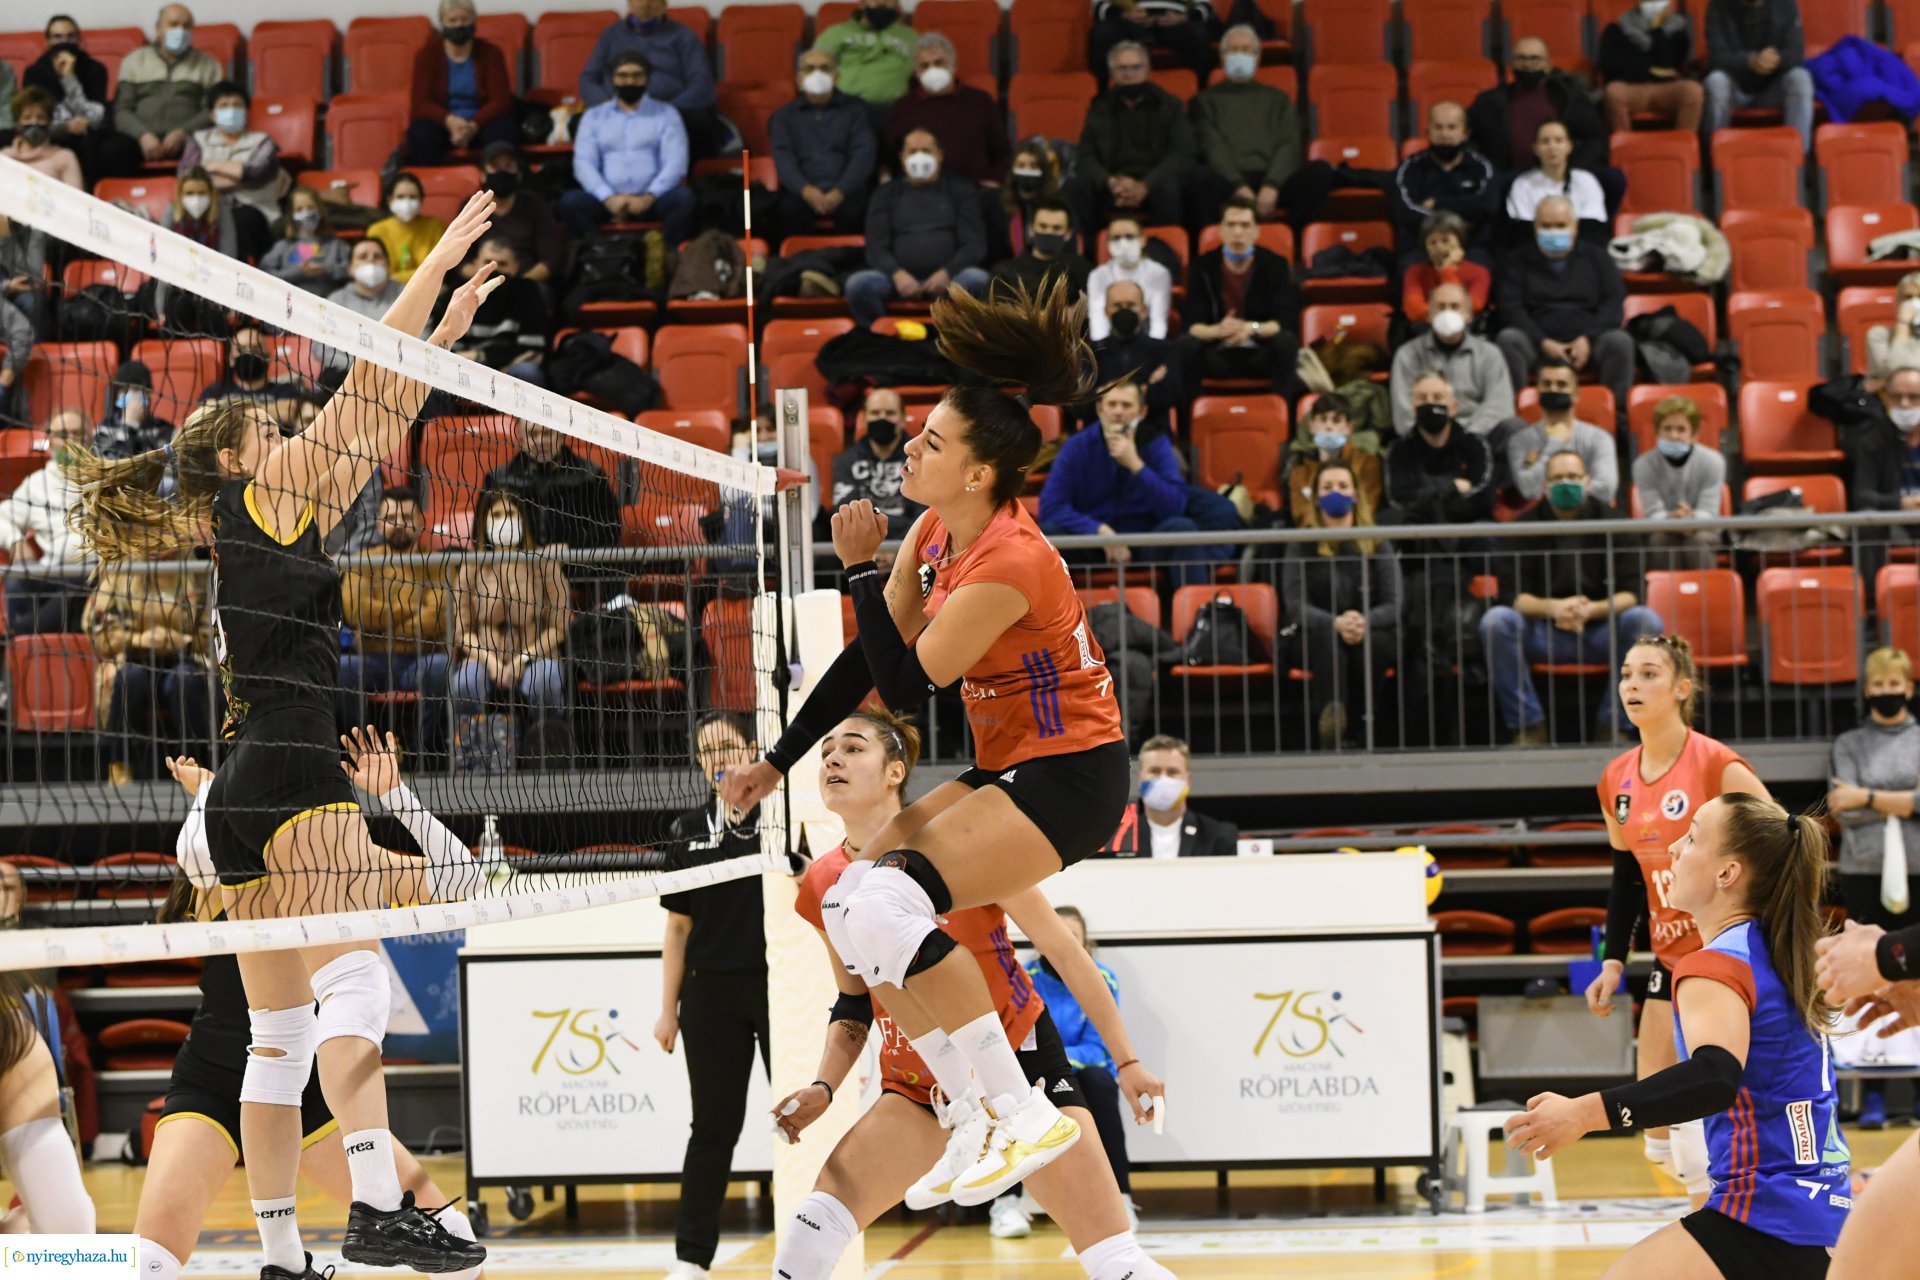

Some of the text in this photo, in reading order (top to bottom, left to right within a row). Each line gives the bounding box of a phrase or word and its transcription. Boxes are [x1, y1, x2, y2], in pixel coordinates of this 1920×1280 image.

[561, 1080, 609, 1090] MAGYAR
[1239, 1074, 1379, 1099] RÖPLABDA
[518, 1090, 655, 1116] RÖPLABDA
[1794, 1104, 1810, 1161] STRABAG
